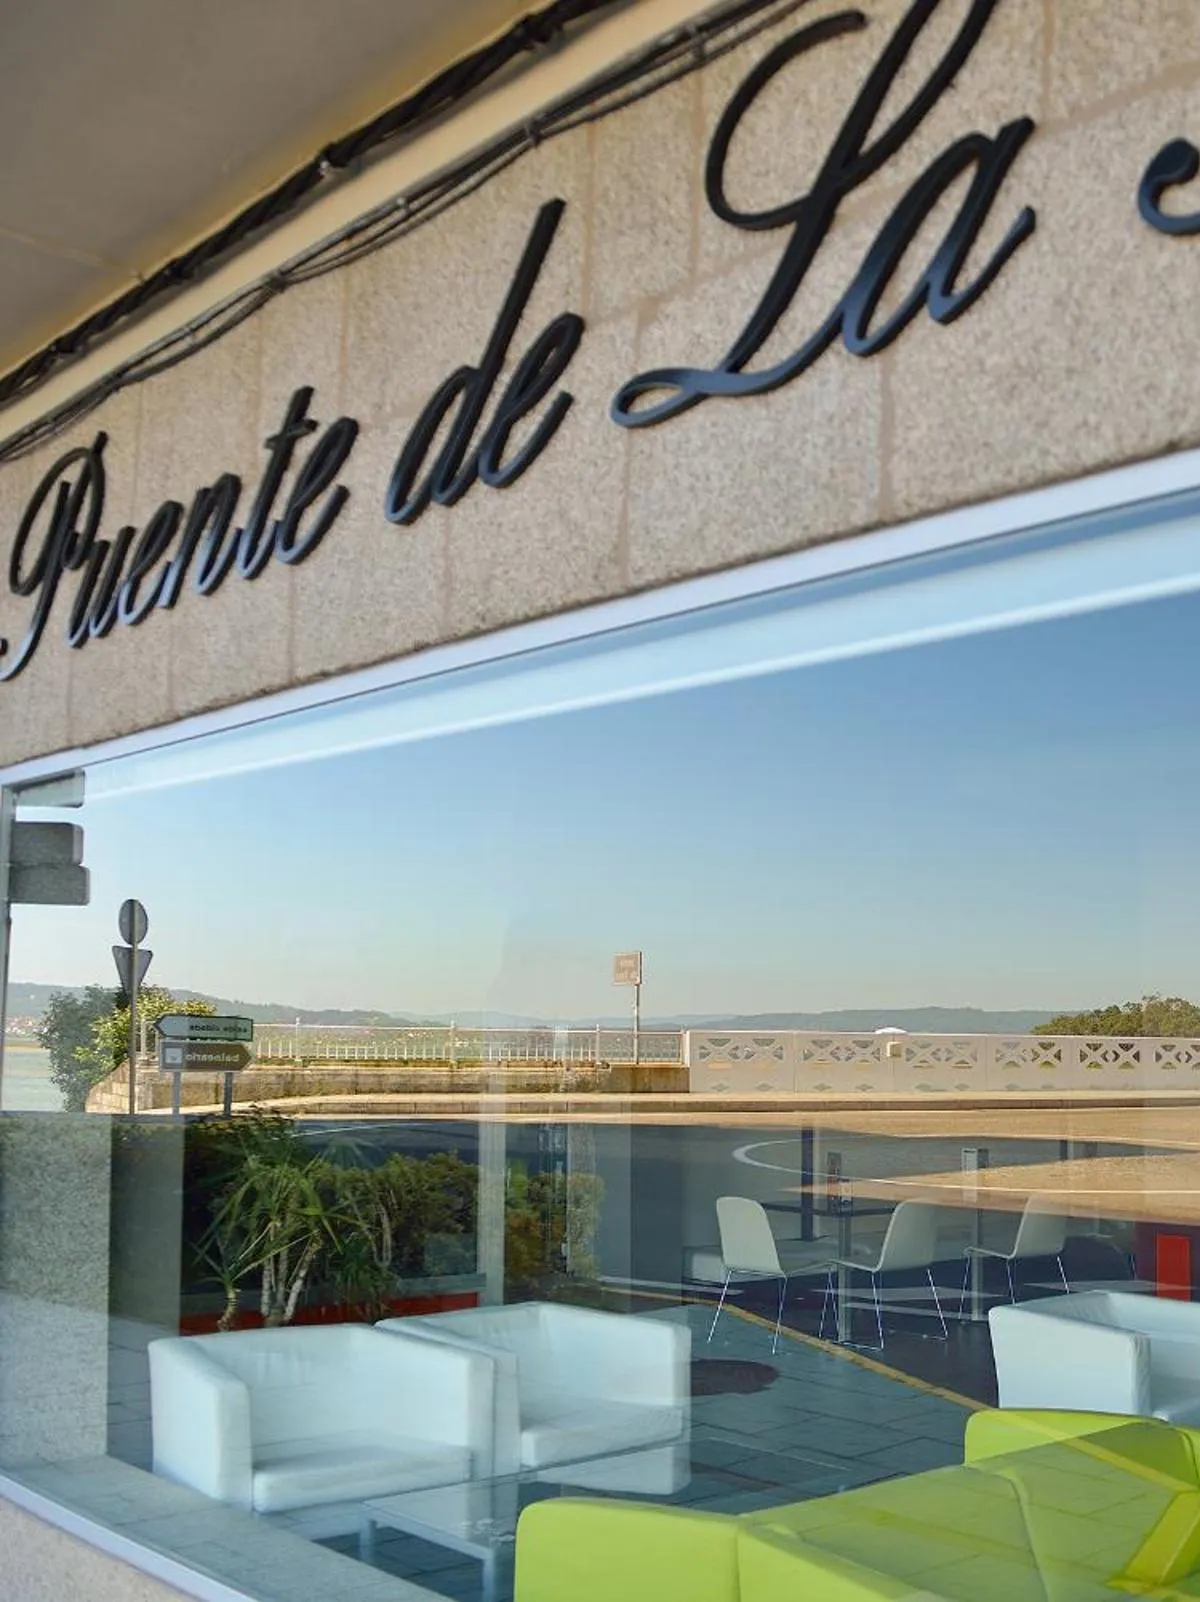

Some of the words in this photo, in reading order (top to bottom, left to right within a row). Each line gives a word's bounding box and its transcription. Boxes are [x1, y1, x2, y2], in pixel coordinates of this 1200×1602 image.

[0, 386, 360, 682] Puente
[385, 198, 586, 526] de
[611, 0, 1036, 428] La
